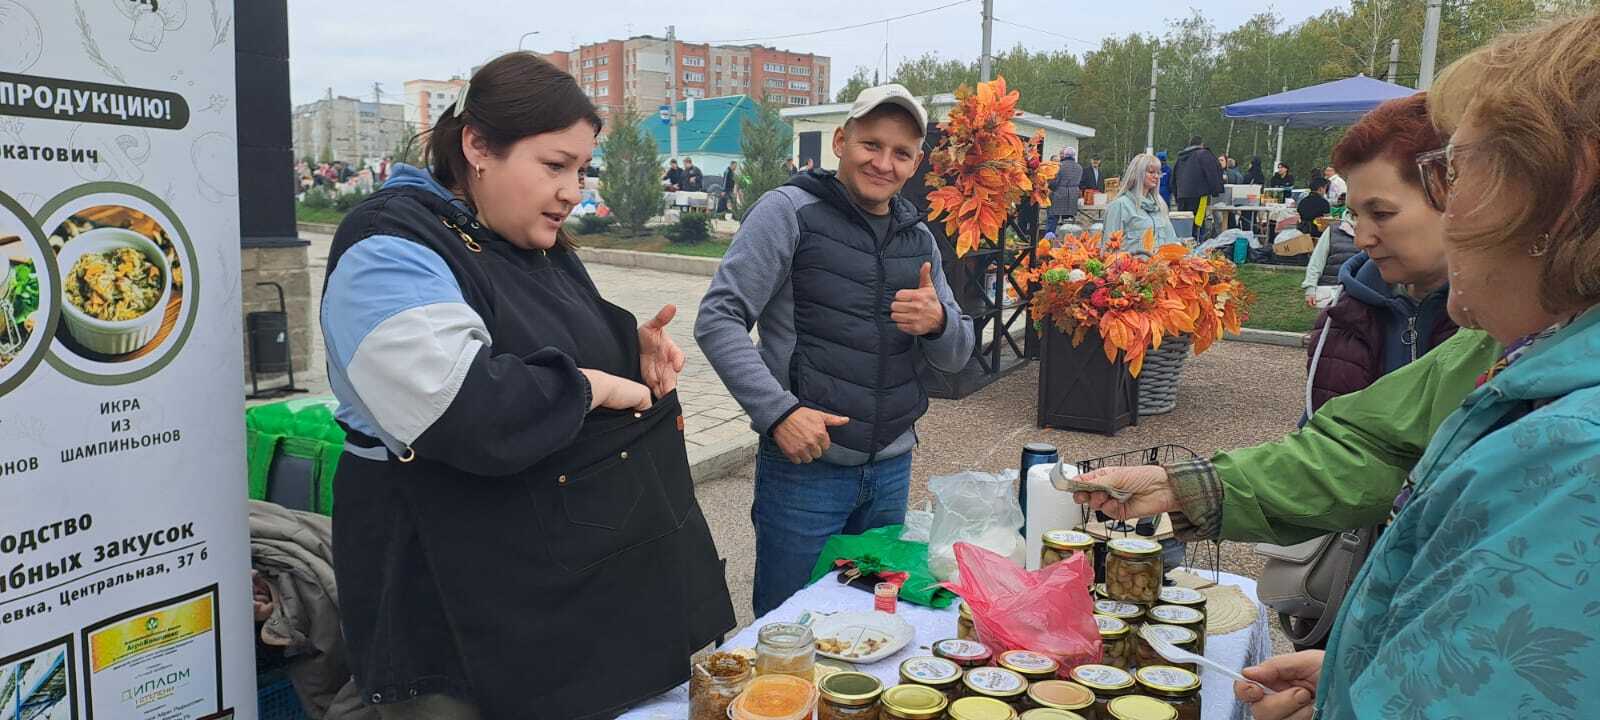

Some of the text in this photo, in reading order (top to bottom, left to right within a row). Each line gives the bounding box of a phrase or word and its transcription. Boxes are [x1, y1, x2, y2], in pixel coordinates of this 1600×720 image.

[0, 81, 171, 120] ПРОДУКЦИЮ!
[0, 144, 99, 164] катович
[100, 398, 141, 415] ИКРА
[111, 418, 131, 432] ИЗ
[61, 429, 181, 463] ШАМПИНЬОНОВ
[0, 513, 93, 554] одство
[94, 522, 195, 562] закусок
[0, 601, 52, 624] евка,
[59, 563, 171, 606] Центральная,
[178, 551, 194, 569] 37
